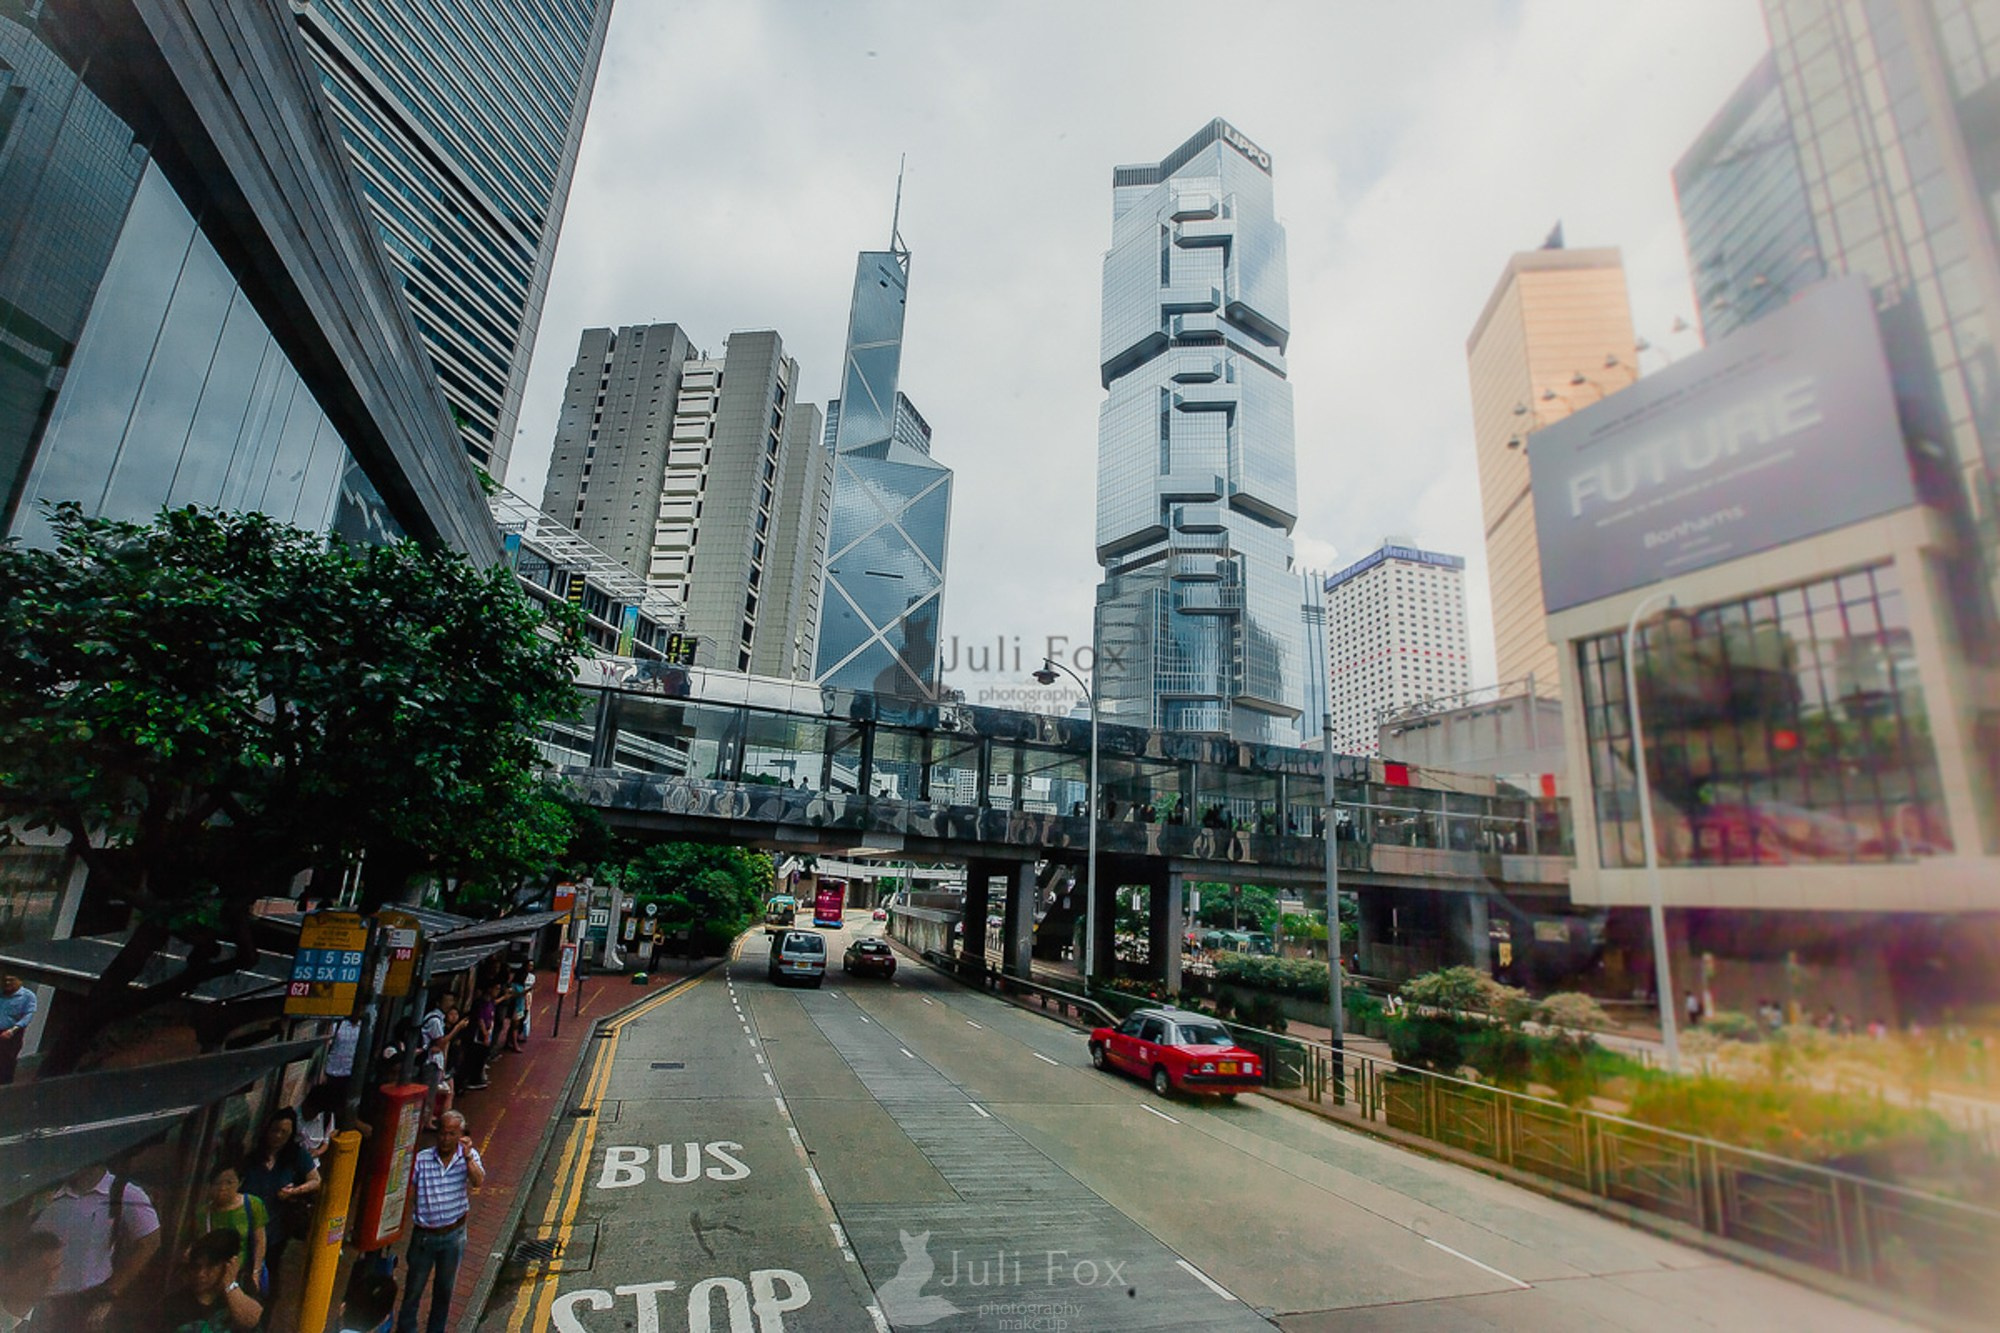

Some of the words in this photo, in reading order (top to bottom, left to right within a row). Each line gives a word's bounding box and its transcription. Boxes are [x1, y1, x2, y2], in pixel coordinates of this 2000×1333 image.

[1224, 126, 1269, 168] LIPPO
[1569, 377, 1823, 518] FUTURE
[1643, 504, 1745, 549] Bonhams
[1384, 546, 1418, 561] Merrill
[1421, 551, 1454, 565] Lynch
[295, 966, 313, 980] 5S
[316, 967, 335, 981] 5X
[341, 968, 356, 981] 10
[304, 951, 311, 962] 1
[325, 952, 334, 964] 5
[342, 952, 361, 965] 5B
[596, 1140, 751, 1189] BUS
